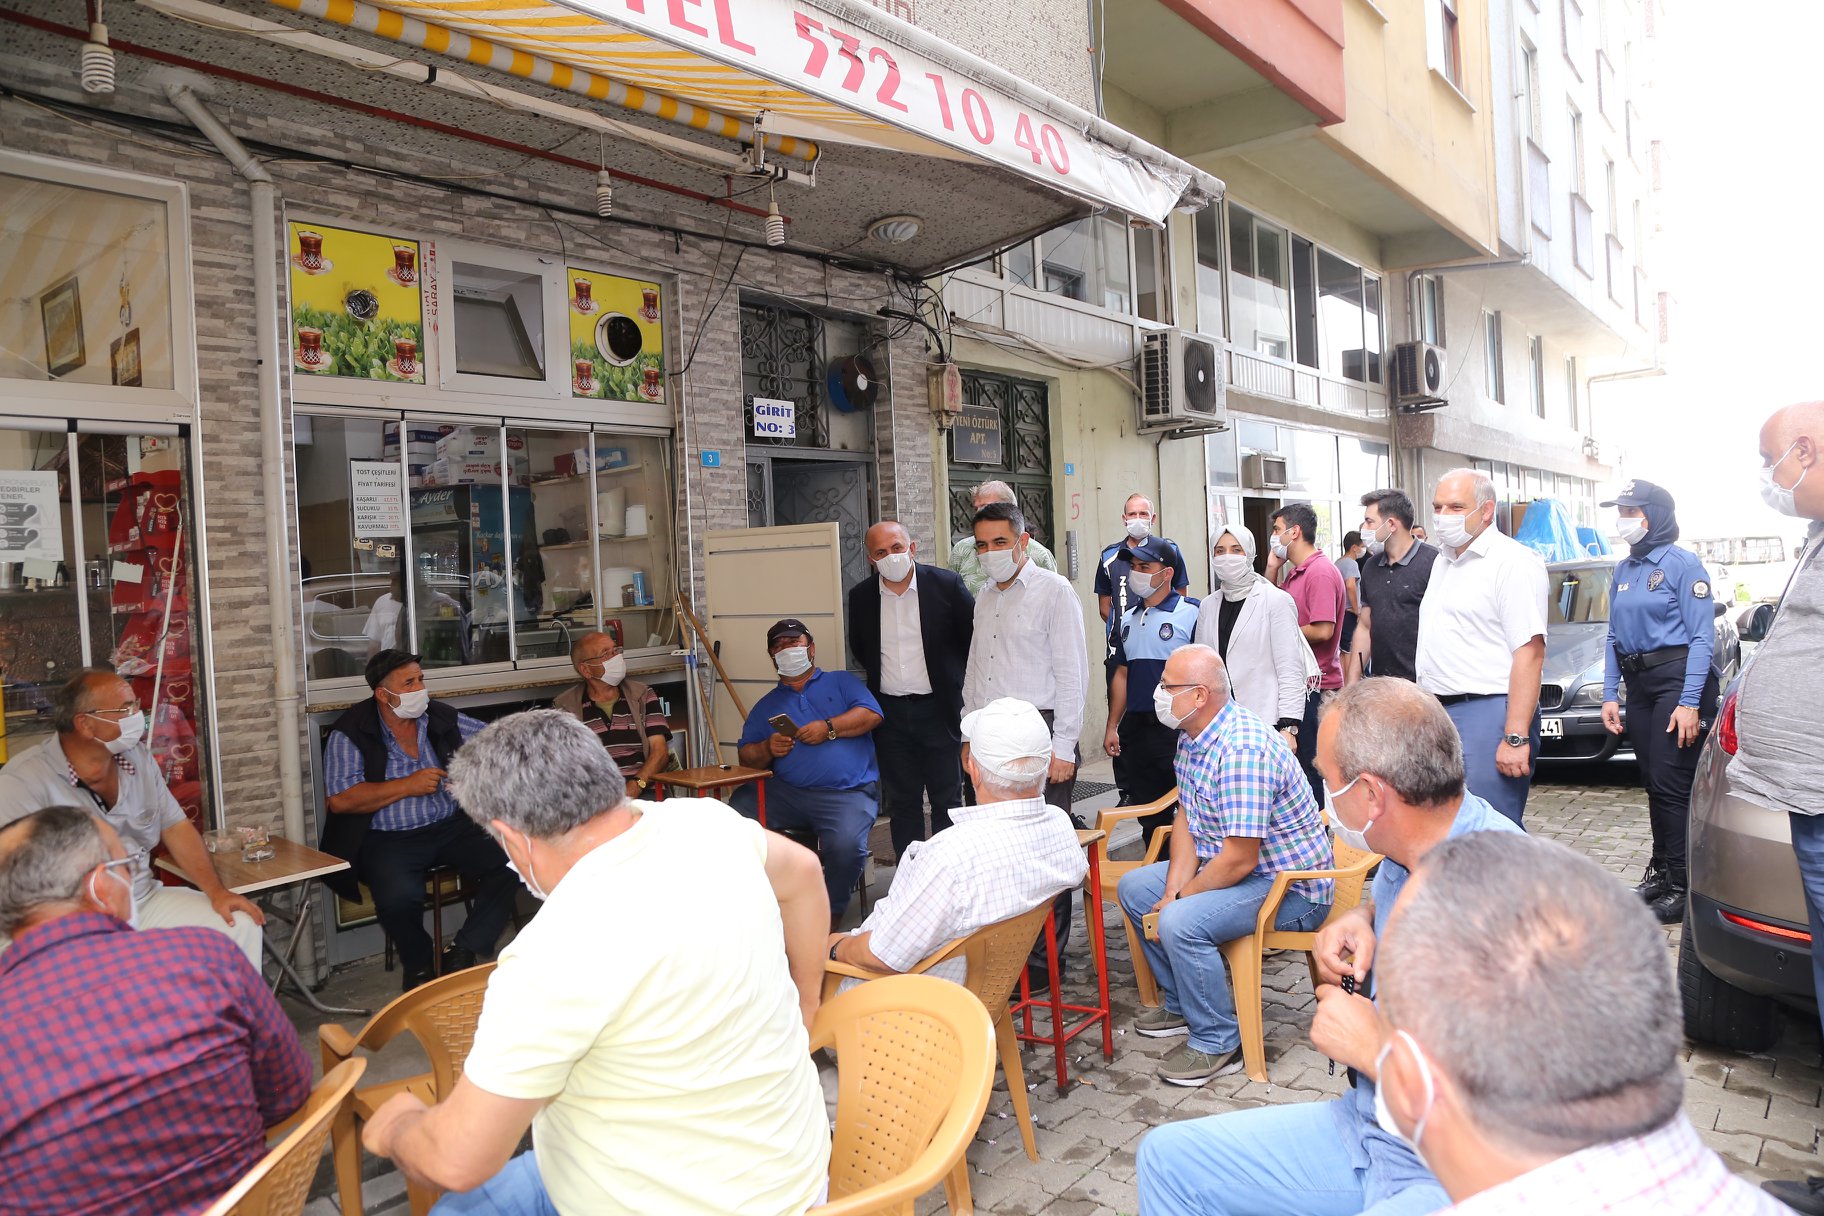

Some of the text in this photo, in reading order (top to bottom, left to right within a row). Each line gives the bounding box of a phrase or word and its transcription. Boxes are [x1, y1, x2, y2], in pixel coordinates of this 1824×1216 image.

[924, 72, 995, 145] 10
[1014, 112, 1070, 175] 40
[430, 276, 438, 316] SARAY
[756, 421, 795, 434] NO: 3
[972, 414, 998, 431] ÖZTÜRK
[969, 432, 987, 445] APT.
[708, 454, 713, 463] 3
[420, 489, 454, 504] Ayder
[1071, 493, 1081, 520] 5
